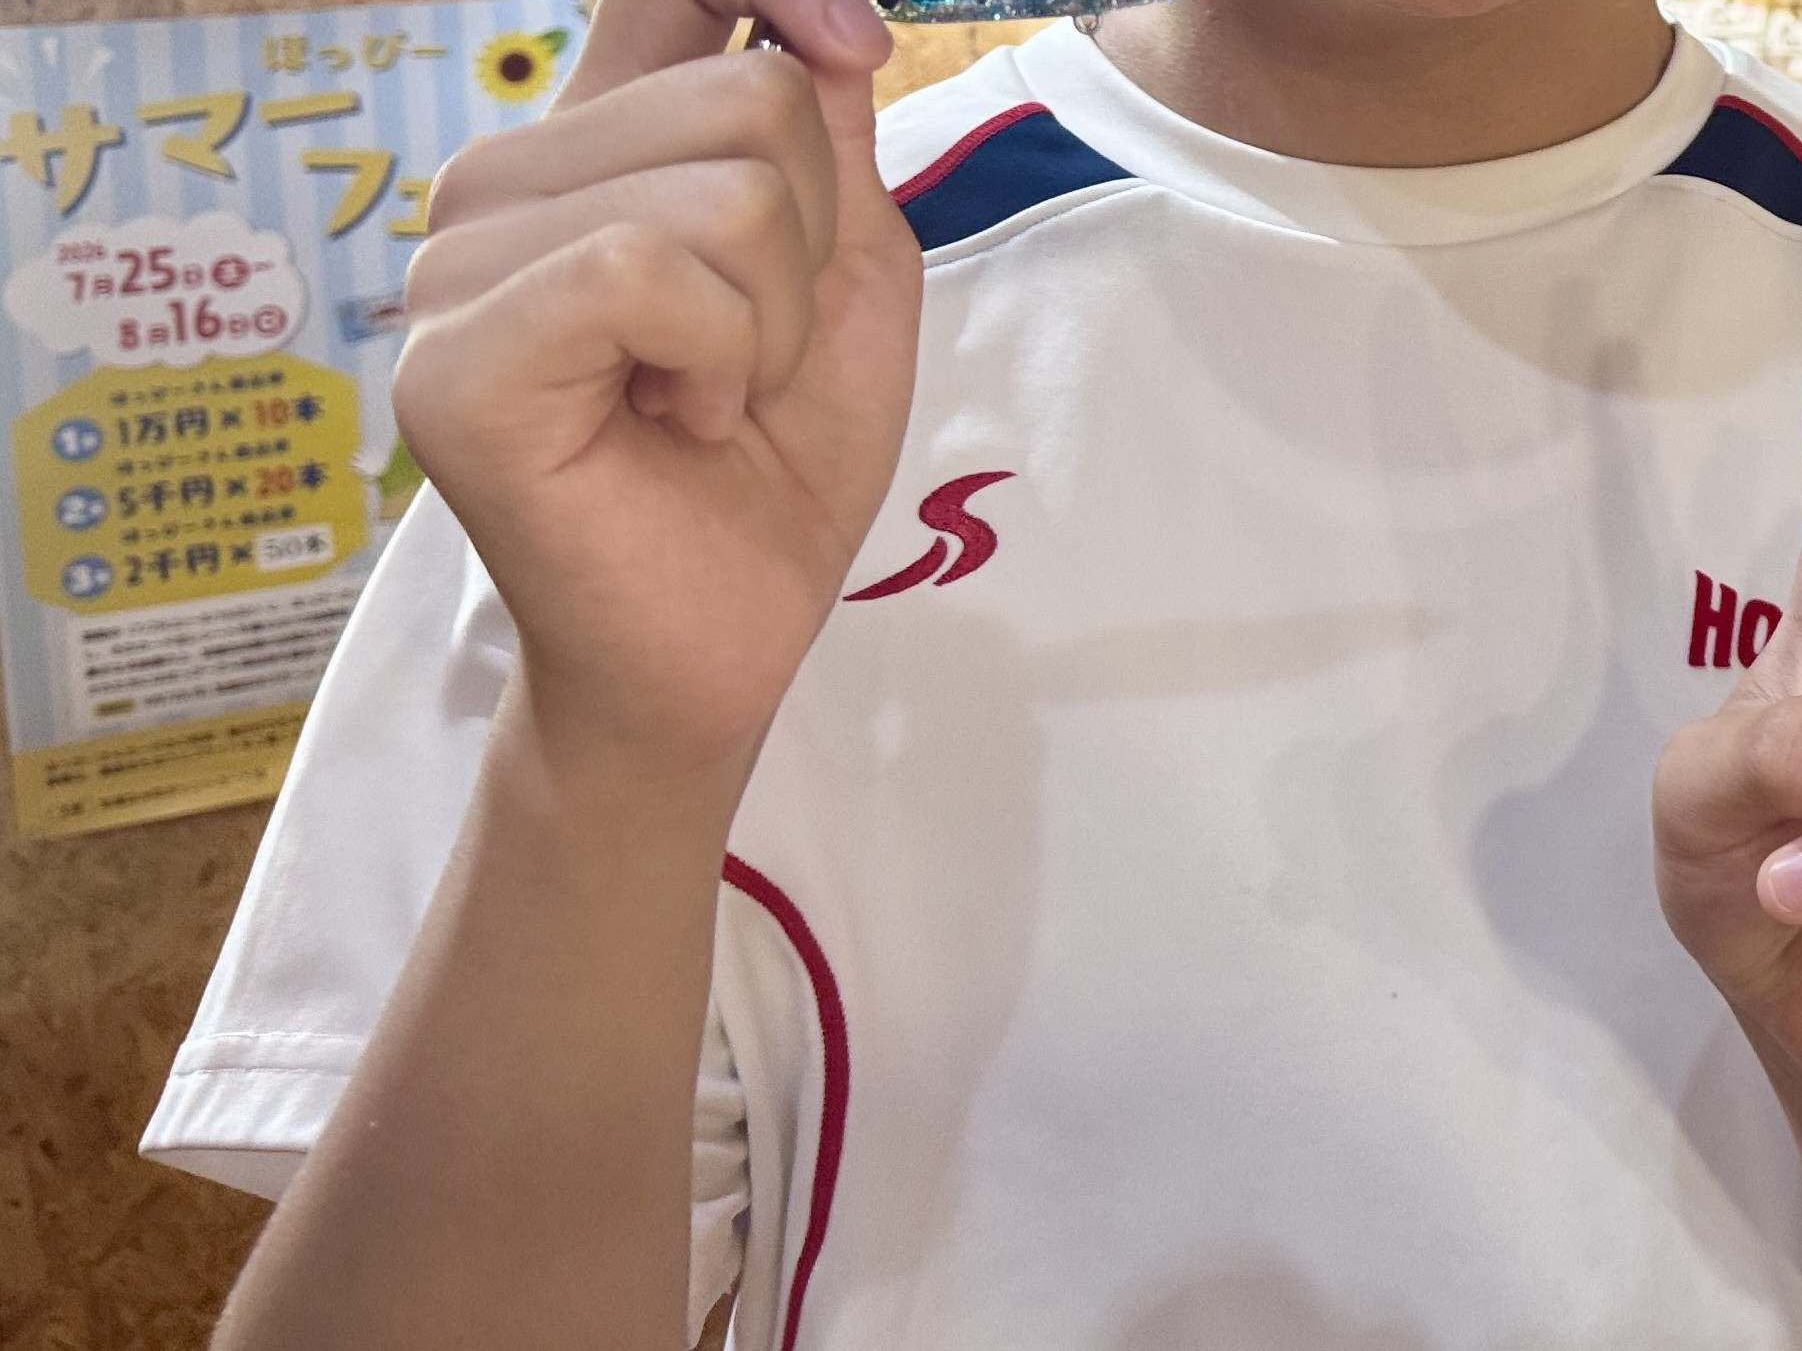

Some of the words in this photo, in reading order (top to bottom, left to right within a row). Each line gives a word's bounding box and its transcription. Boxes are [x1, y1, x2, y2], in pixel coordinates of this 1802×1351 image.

[0, 89, 361, 217] サマー
[1688, 569, 1783, 669] HO
